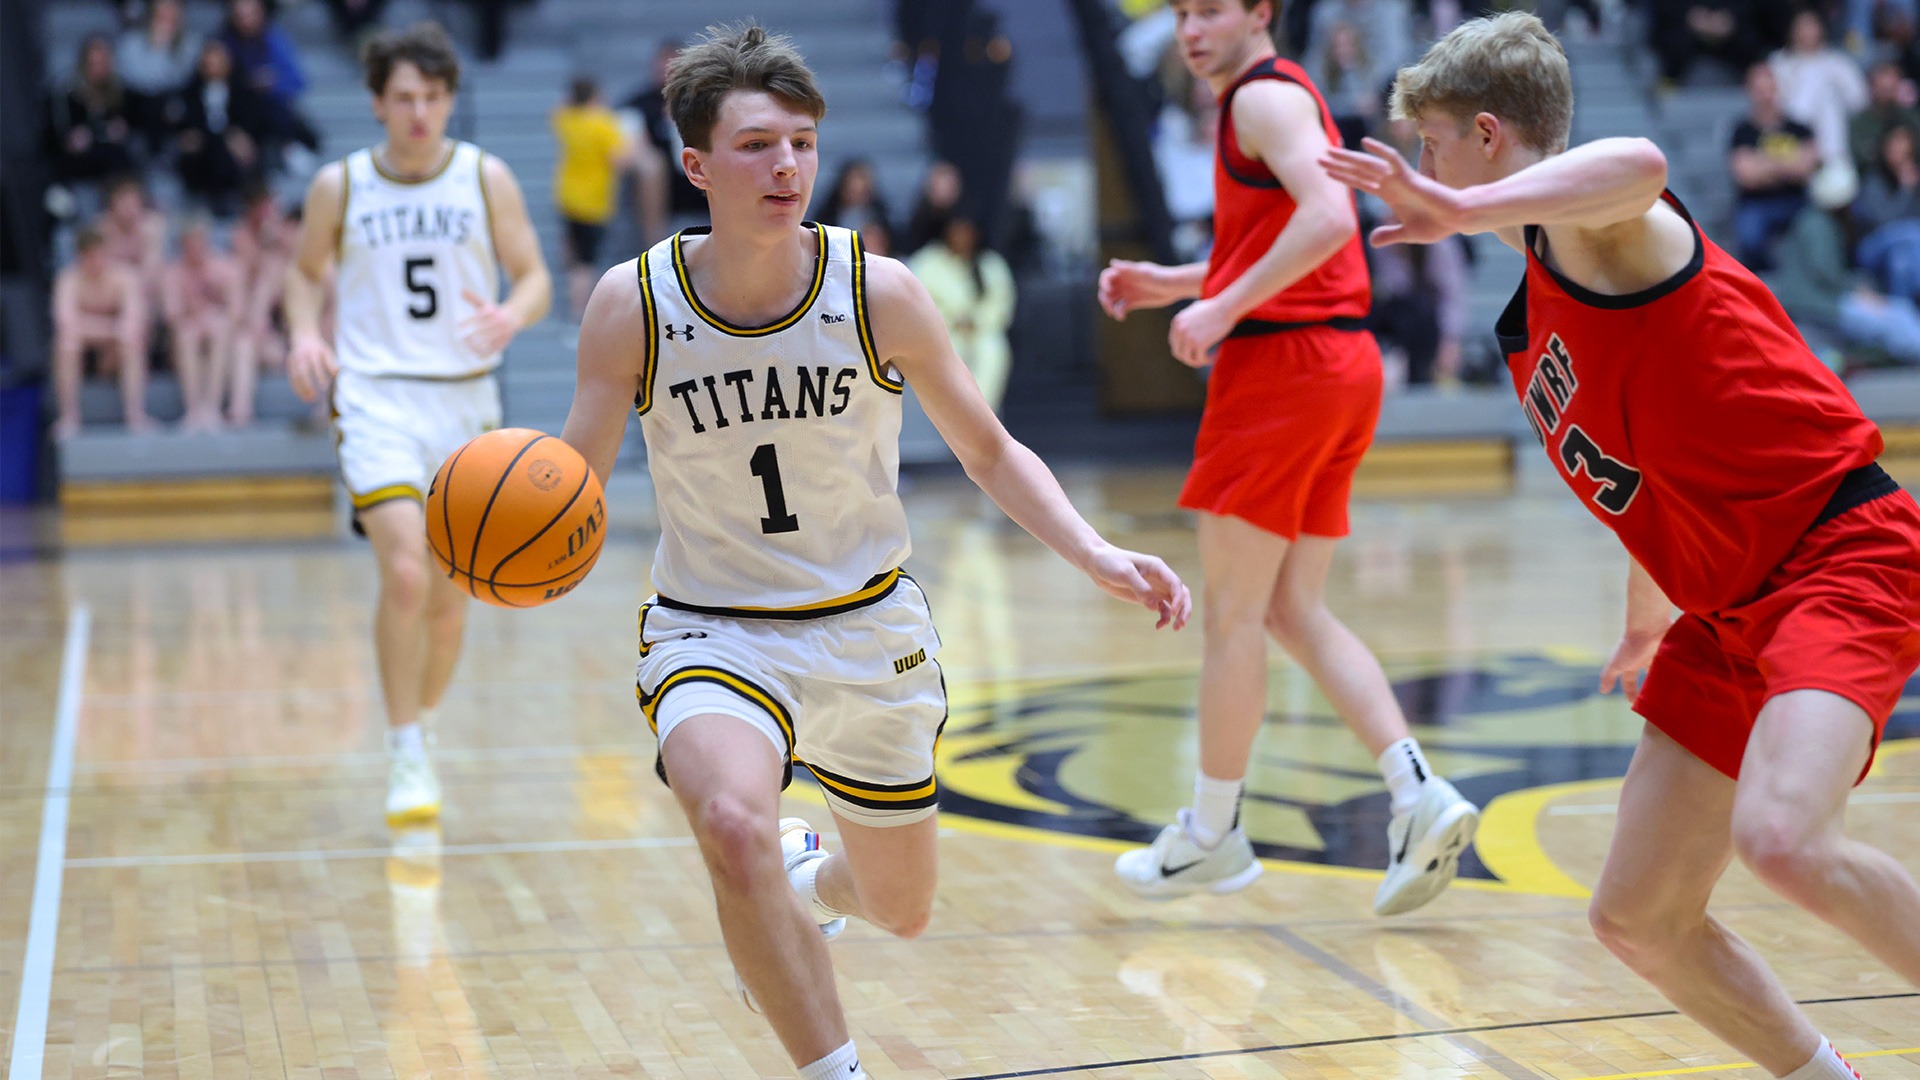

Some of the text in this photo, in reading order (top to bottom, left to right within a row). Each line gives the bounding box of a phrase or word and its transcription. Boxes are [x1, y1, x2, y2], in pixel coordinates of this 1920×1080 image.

[359, 204, 473, 249] TITANS
[404, 255, 438, 320] 5
[669, 366, 858, 434] TITANS
[1522, 331, 1579, 450] UWRF
[749, 443, 800, 534] 1
[1559, 422, 1643, 516] 3
[893, 647, 927, 675] UWO
